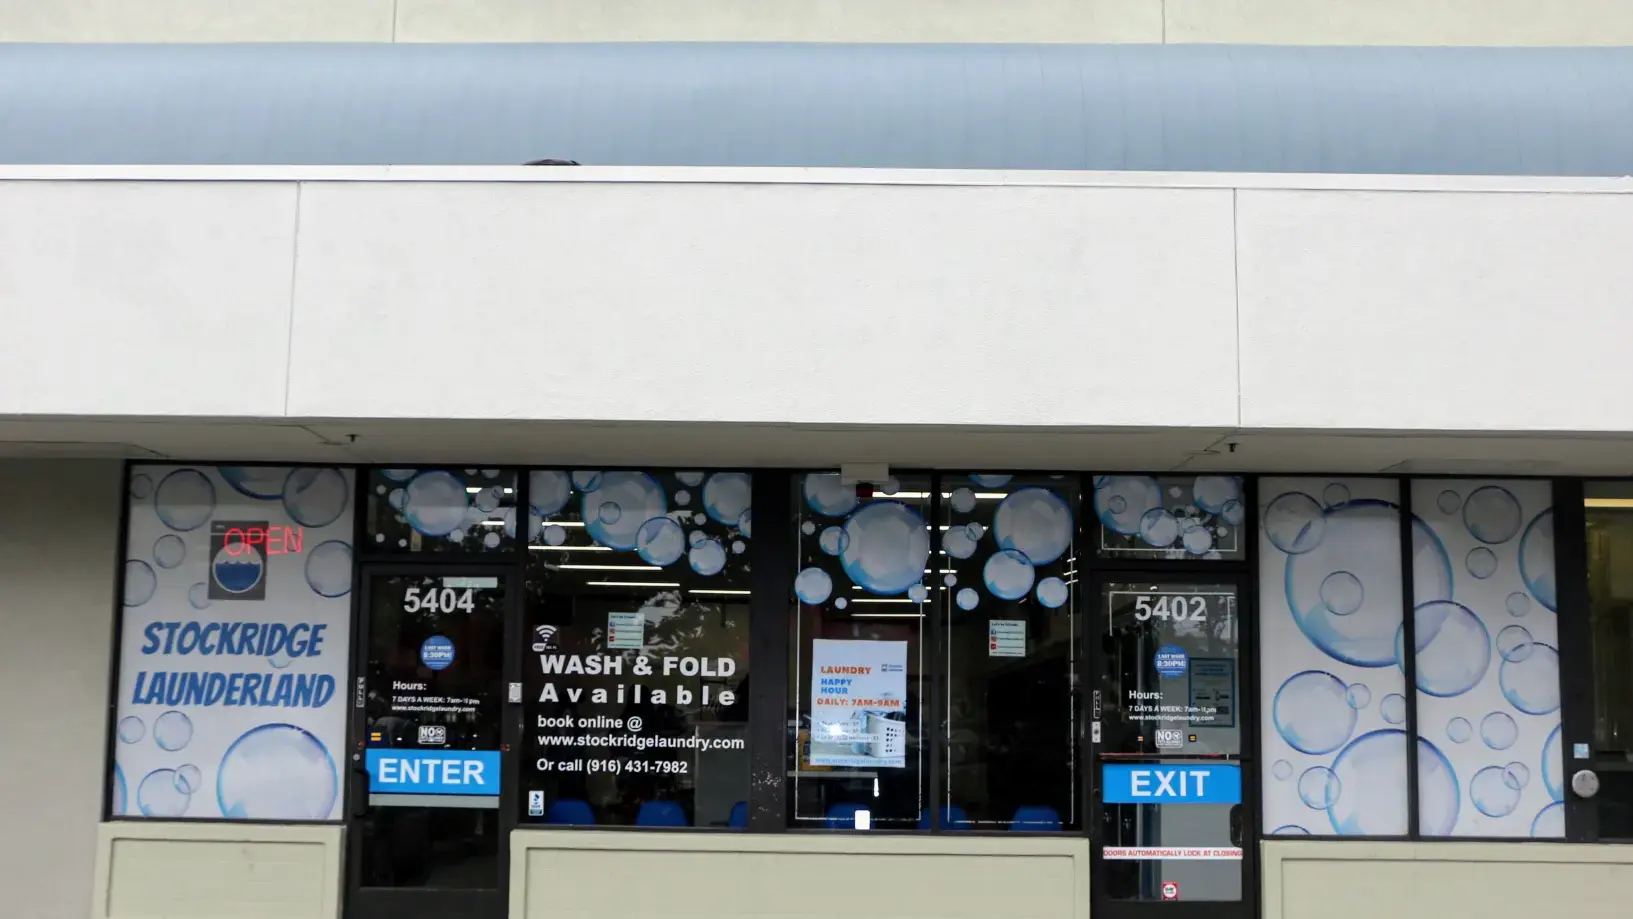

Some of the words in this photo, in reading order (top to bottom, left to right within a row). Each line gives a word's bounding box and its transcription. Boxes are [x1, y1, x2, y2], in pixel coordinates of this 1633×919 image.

[223, 524, 304, 556] OPEN
[403, 587, 475, 613] 5404
[1134, 595, 1207, 621] 5402
[141, 621, 327, 658] STOCKRIDGE
[540, 654, 622, 675] WASH
[632, 655, 653, 676] &
[663, 657, 736, 677] FOLD
[820, 666, 872, 674] LAUNDRY
[132, 671, 335, 708] LAUNDERLAND
[392, 681, 427, 691] Hours:
[821, 678, 852, 686] HAPPY
[538, 683, 736, 706] Available
[817, 698, 848, 706] DAILY:
[852, 699, 900, 707] 7AM-9AM
[1128, 690, 1163, 700] Hours:
[537, 715, 574, 728] book
[578, 715, 623, 729] online
[627, 716, 643, 732] @
[1128, 714, 1215, 722] www.stockridgelaundry.com
[421, 727, 435, 737] NO
[1158, 731, 1172, 740] NO
[537, 734, 745, 751] www.stockridgelaundry.com
[379, 758, 485, 785] ENTER
[536, 758, 554, 771] Or
[558, 759, 583, 772] call
[586, 759, 621, 775] (916)
[624, 761, 688, 774] 431-7982
[1131, 770, 1211, 797] EXIT
